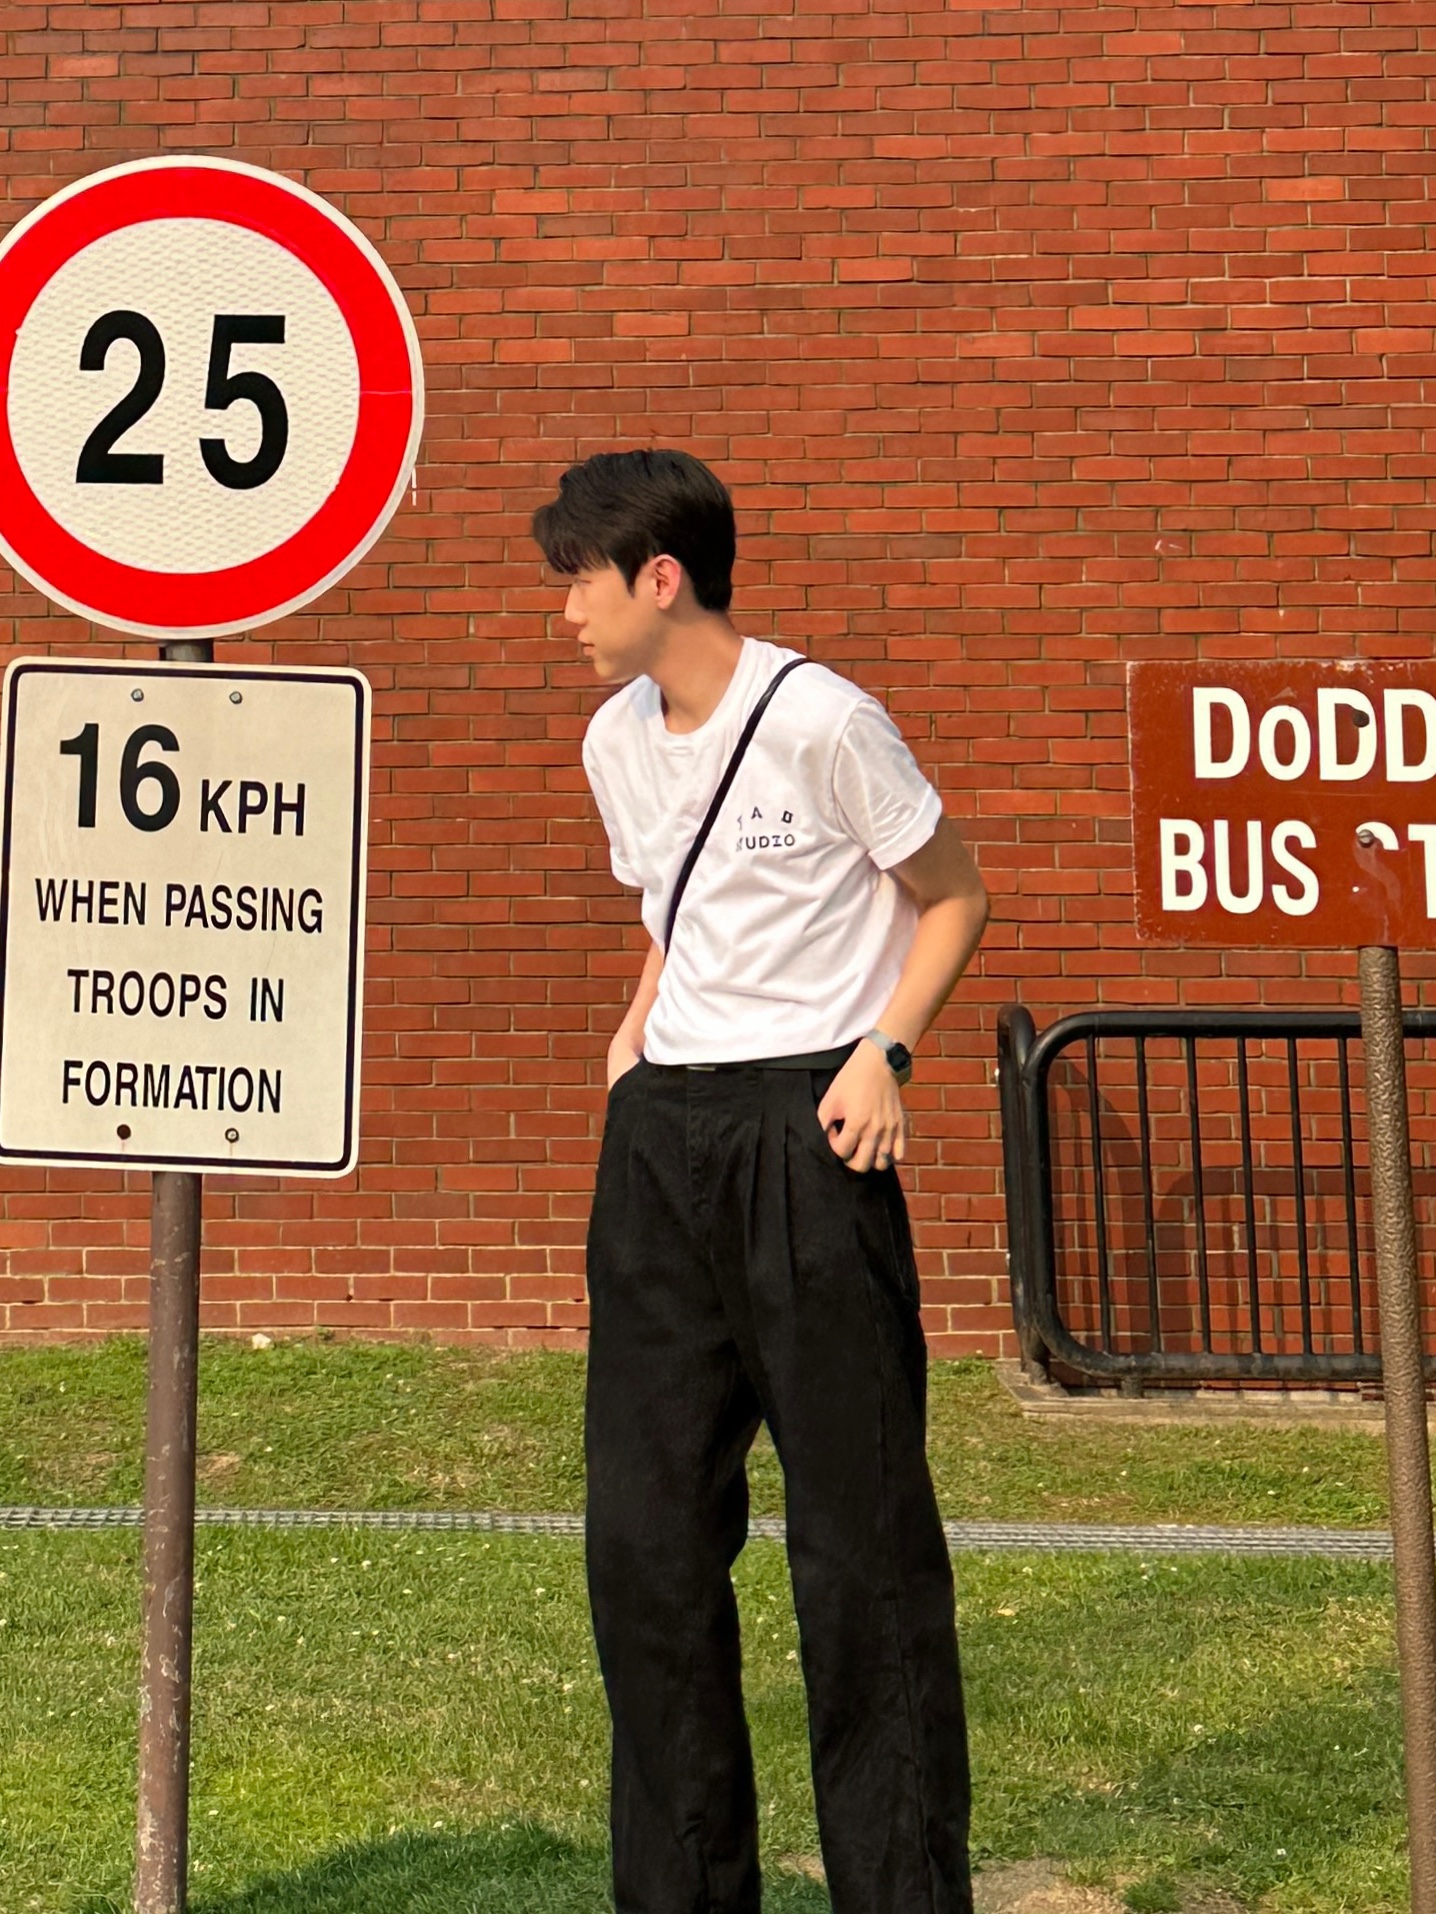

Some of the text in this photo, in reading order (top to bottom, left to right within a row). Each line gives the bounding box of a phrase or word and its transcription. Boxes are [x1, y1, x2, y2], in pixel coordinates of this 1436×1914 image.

[75, 309, 289, 490] 25
[59, 722, 306, 837] 16 KPH
[35, 877, 323, 934] WHEN PASSING
[1159, 818, 1320, 917] BUS
[67, 968, 284, 1023] TROOPS IN
[62, 1059, 282, 1114] FORMATION
